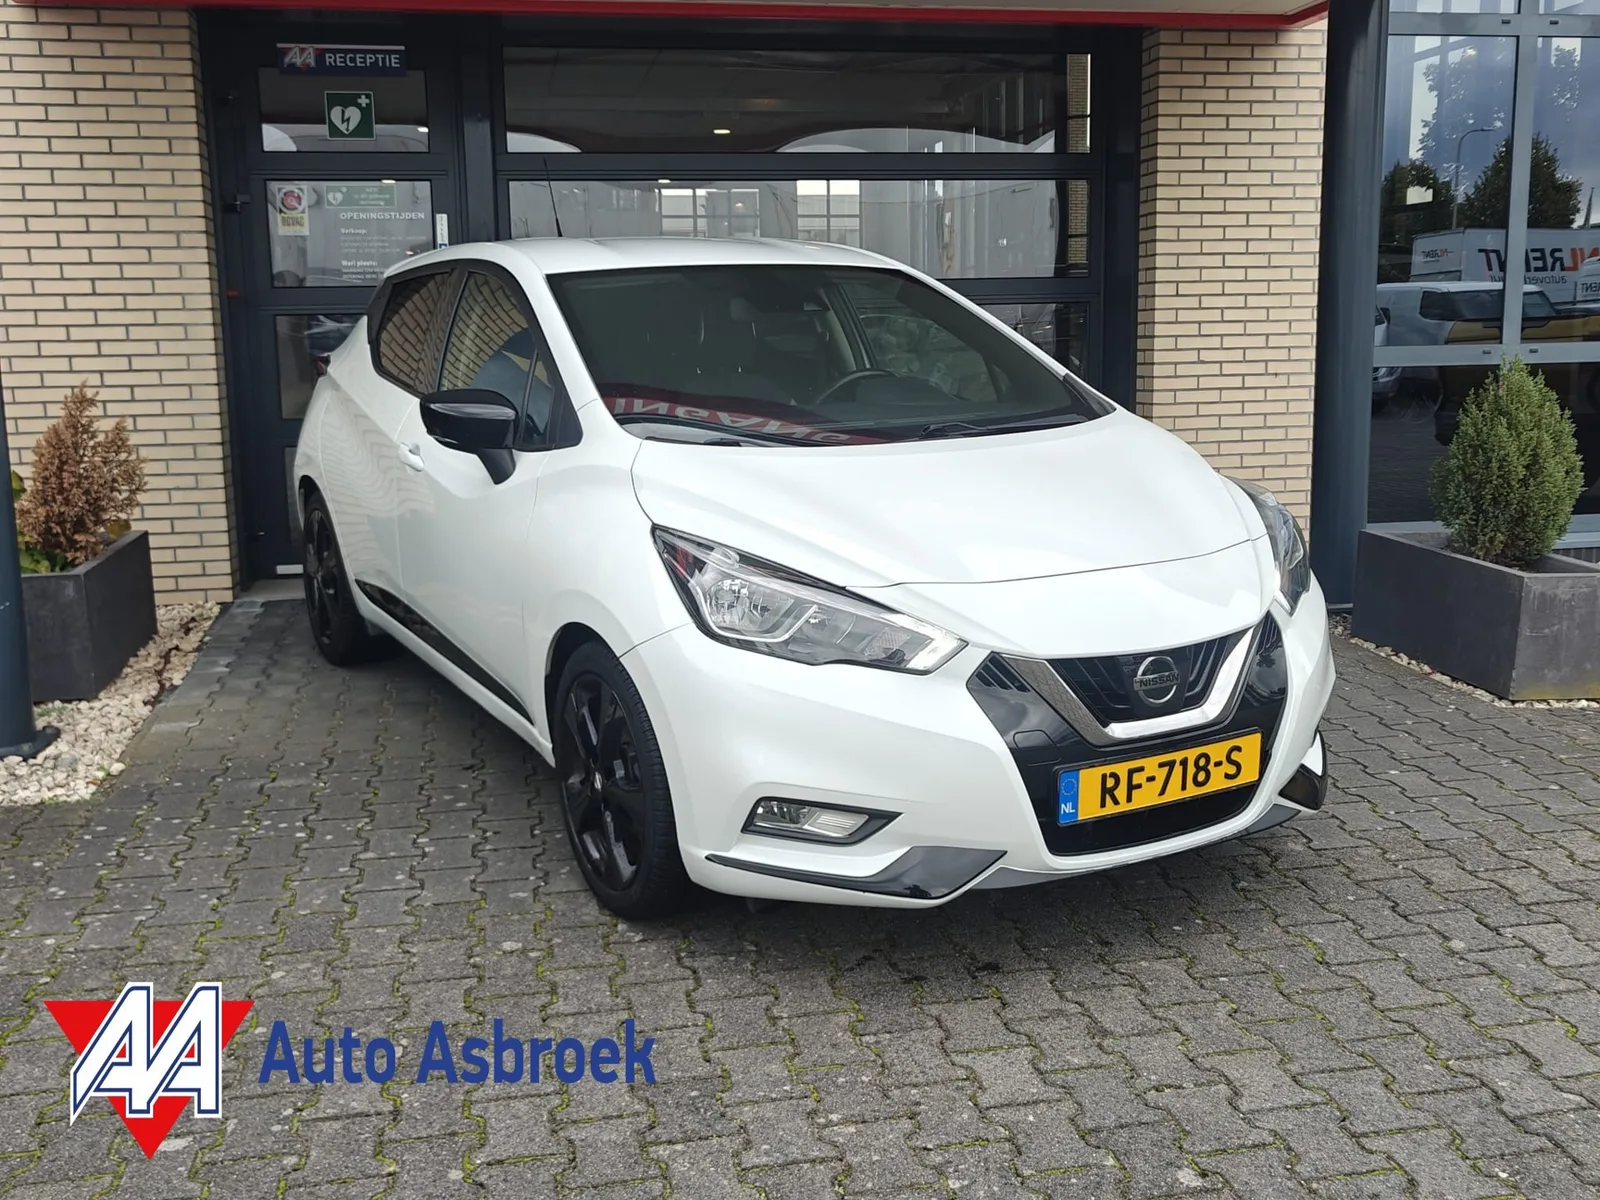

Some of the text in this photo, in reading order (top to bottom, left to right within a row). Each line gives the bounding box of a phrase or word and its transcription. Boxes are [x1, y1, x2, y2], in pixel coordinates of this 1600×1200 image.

[325, 53, 401, 68] RECEPTIE
[339, 211, 425, 220] OPENINGSTIJDEN
[1139, 671, 1180, 688] NISSAN
[1099, 744, 1243, 809] RF-718-S
[1060, 802, 1075, 815] NL
